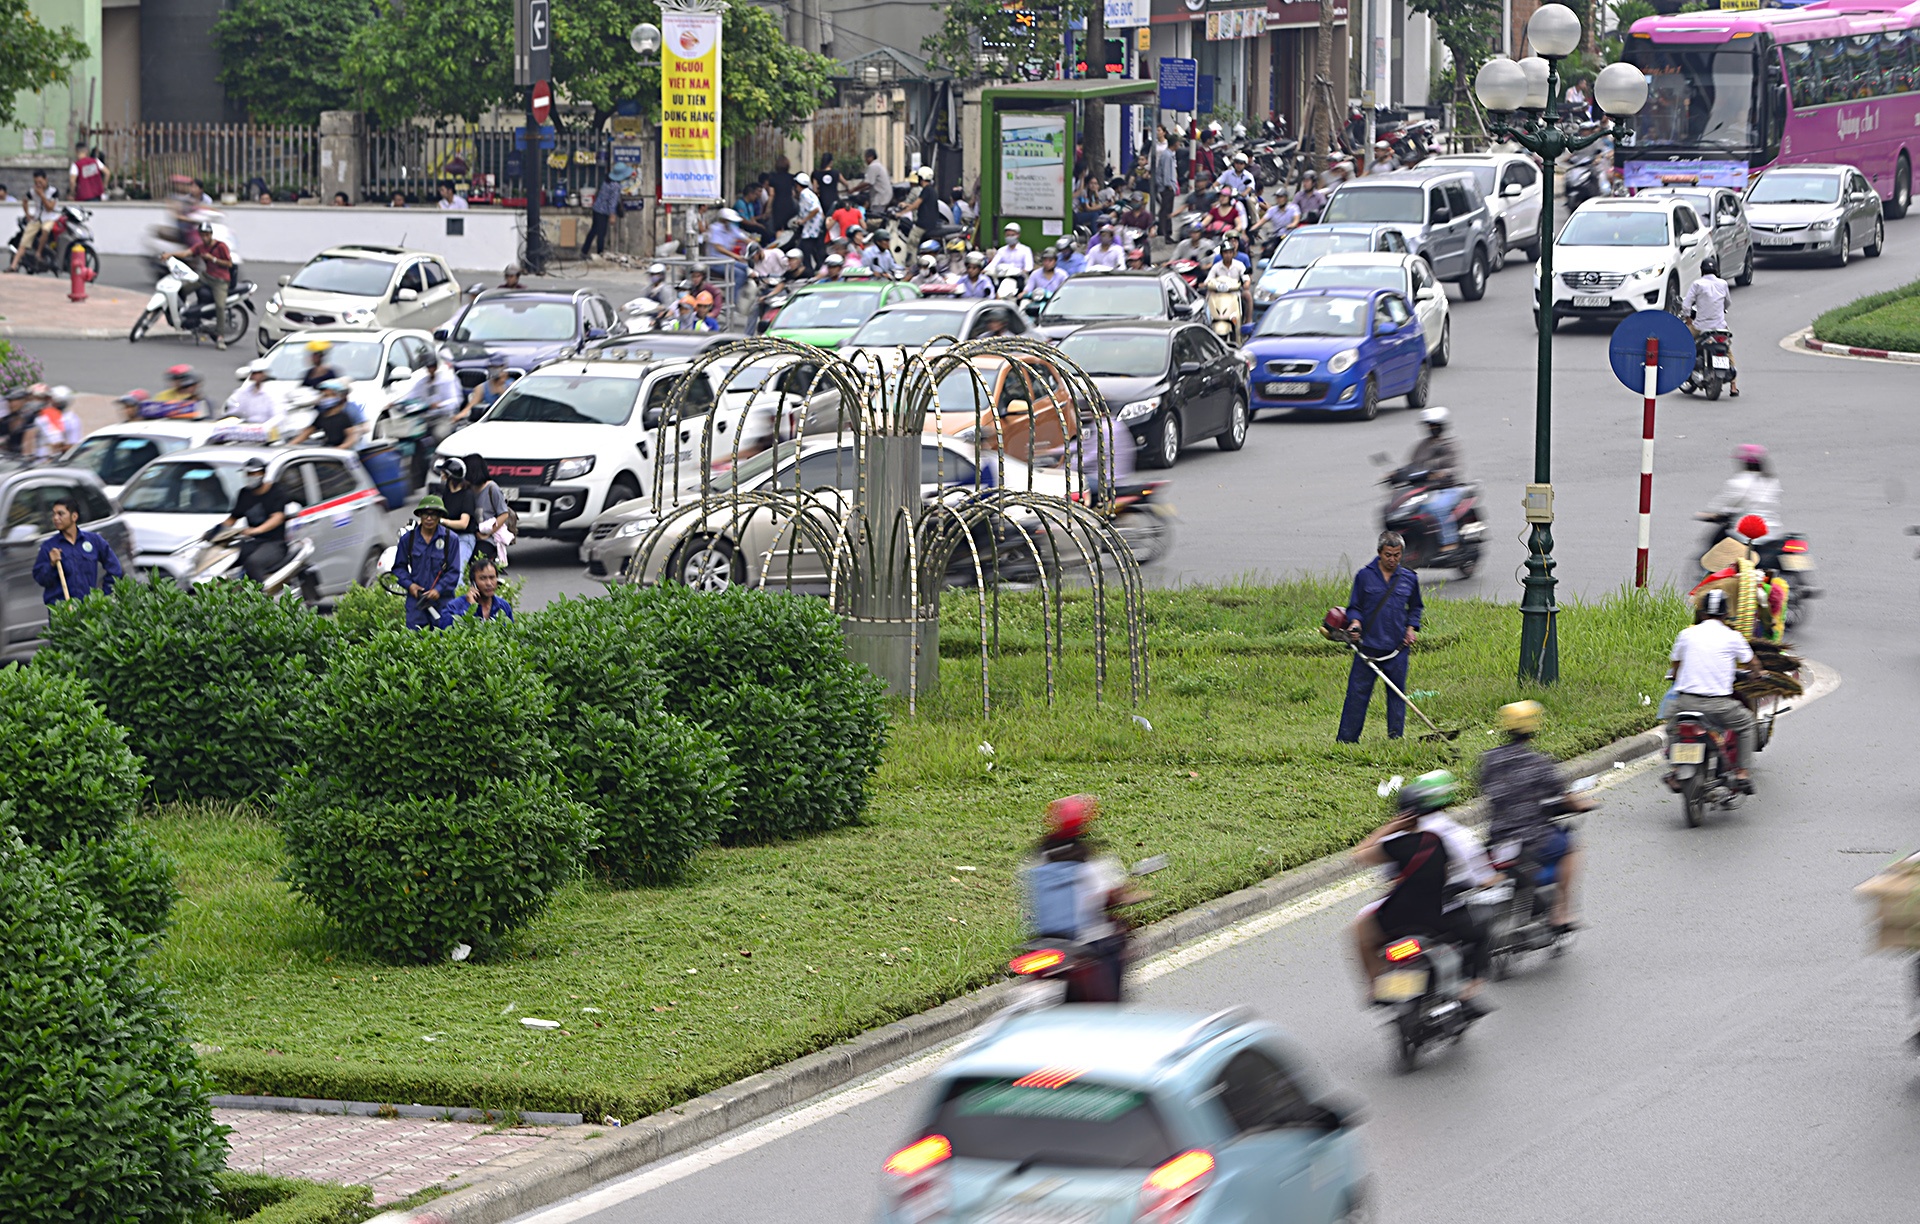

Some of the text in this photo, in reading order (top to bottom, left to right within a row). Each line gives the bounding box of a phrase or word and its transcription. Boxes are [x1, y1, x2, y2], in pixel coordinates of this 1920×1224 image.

[689, 78, 711, 89] NAM
[689, 127, 710, 139] NAM
[664, 171, 715, 182] vinaphone
